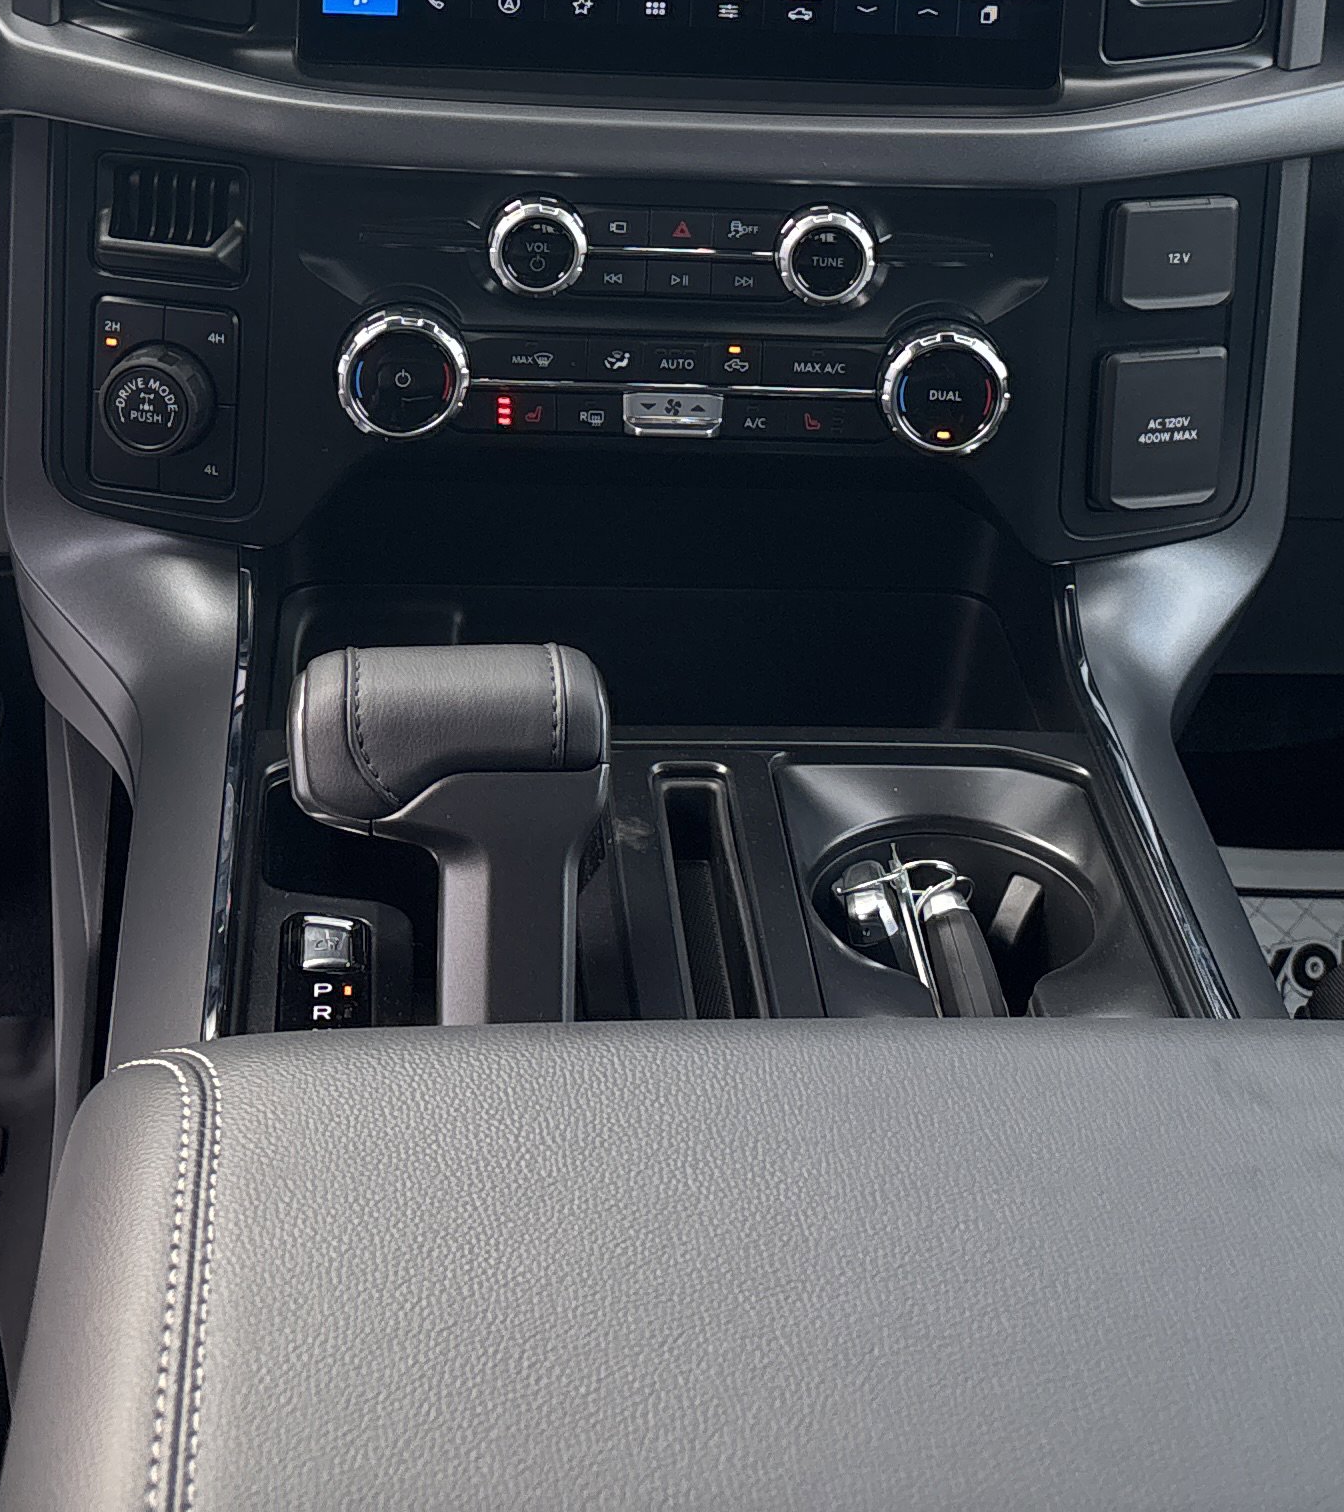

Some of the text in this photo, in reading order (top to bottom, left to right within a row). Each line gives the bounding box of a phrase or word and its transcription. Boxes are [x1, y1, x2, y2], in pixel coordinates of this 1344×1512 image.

[525, 242, 550, 252] VOL
[811, 256, 844, 268] TUNE
[1168, 252, 1191, 264] 12 V
[105, 320, 121, 332] 2H
[208, 332, 225, 344] 4H
[512, 355, 534, 364] MAX
[660, 359, 846, 374] AUTO MAX A/C
[115, 377, 179, 413] DRIVE MODE
[929, 390, 962, 402] DUAL
[130, 410, 162, 424] PUSH
[744, 417, 767, 429] A/C
[1147, 416, 1191, 430] AC 120V
[1138, 429, 1198, 444] 400W MAX
[204, 464, 219, 476] 4L
[313, 982, 333, 998] P
[312, 1005, 332, 1021] R
